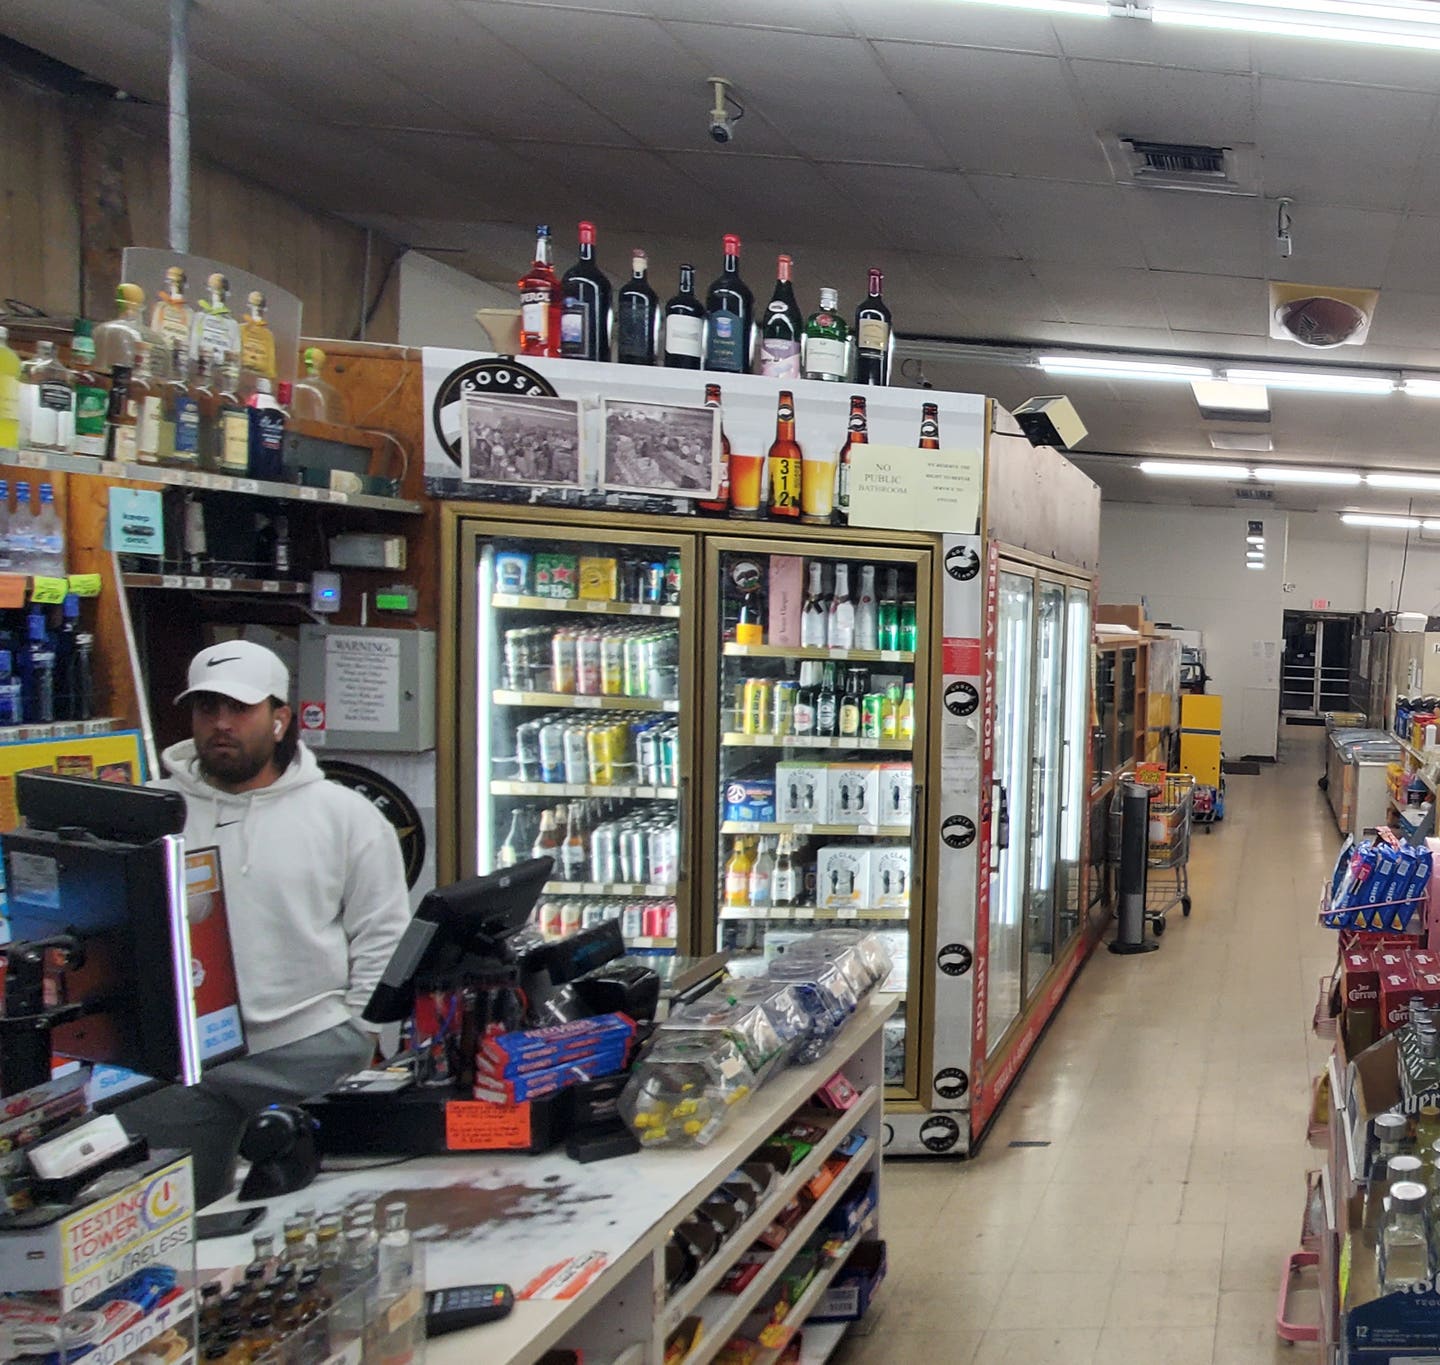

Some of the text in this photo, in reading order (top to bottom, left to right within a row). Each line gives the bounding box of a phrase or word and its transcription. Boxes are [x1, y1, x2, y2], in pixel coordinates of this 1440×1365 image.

[521, 292, 551, 303] PEROL
[460, 370, 542, 398] GOOSE
[876, 463, 892, 471] NO
[864, 473, 901, 483] PUBLIC
[858, 484, 908, 494] BATHROOM
[984, 669, 993, 761] ARTOIS
[70, 1190, 145, 1242] TESTING
[72, 1215, 138, 1262] TOWER
[1356, 1326, 1369, 1338] 12
